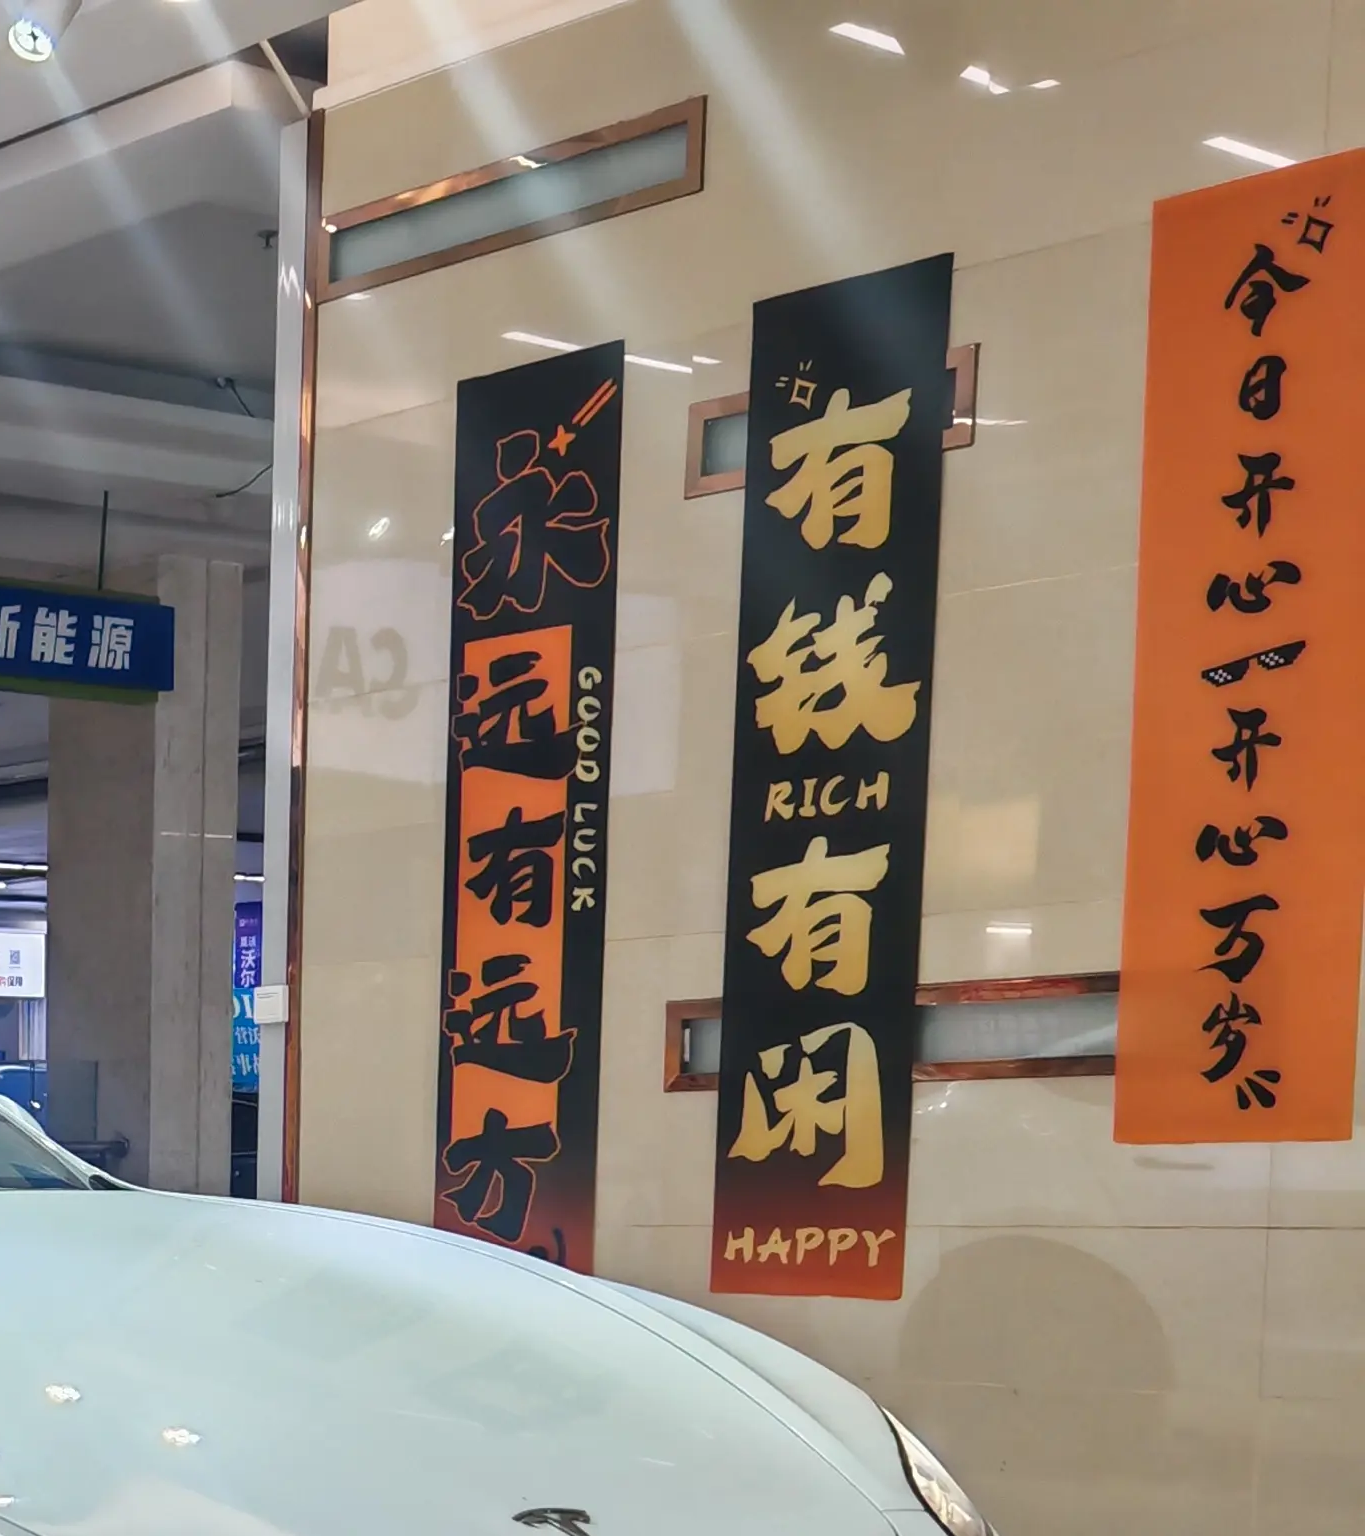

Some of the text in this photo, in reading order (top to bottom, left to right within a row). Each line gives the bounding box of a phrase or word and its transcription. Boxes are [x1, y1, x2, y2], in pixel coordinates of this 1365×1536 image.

[747, 387, 921, 756] 有钱
[570, 666, 602, 911] GOOD LUCK
[767, 770, 890, 822] RICH
[727, 836, 890, 1189] 有闲
[724, 1226, 897, 1266] HAPPY
